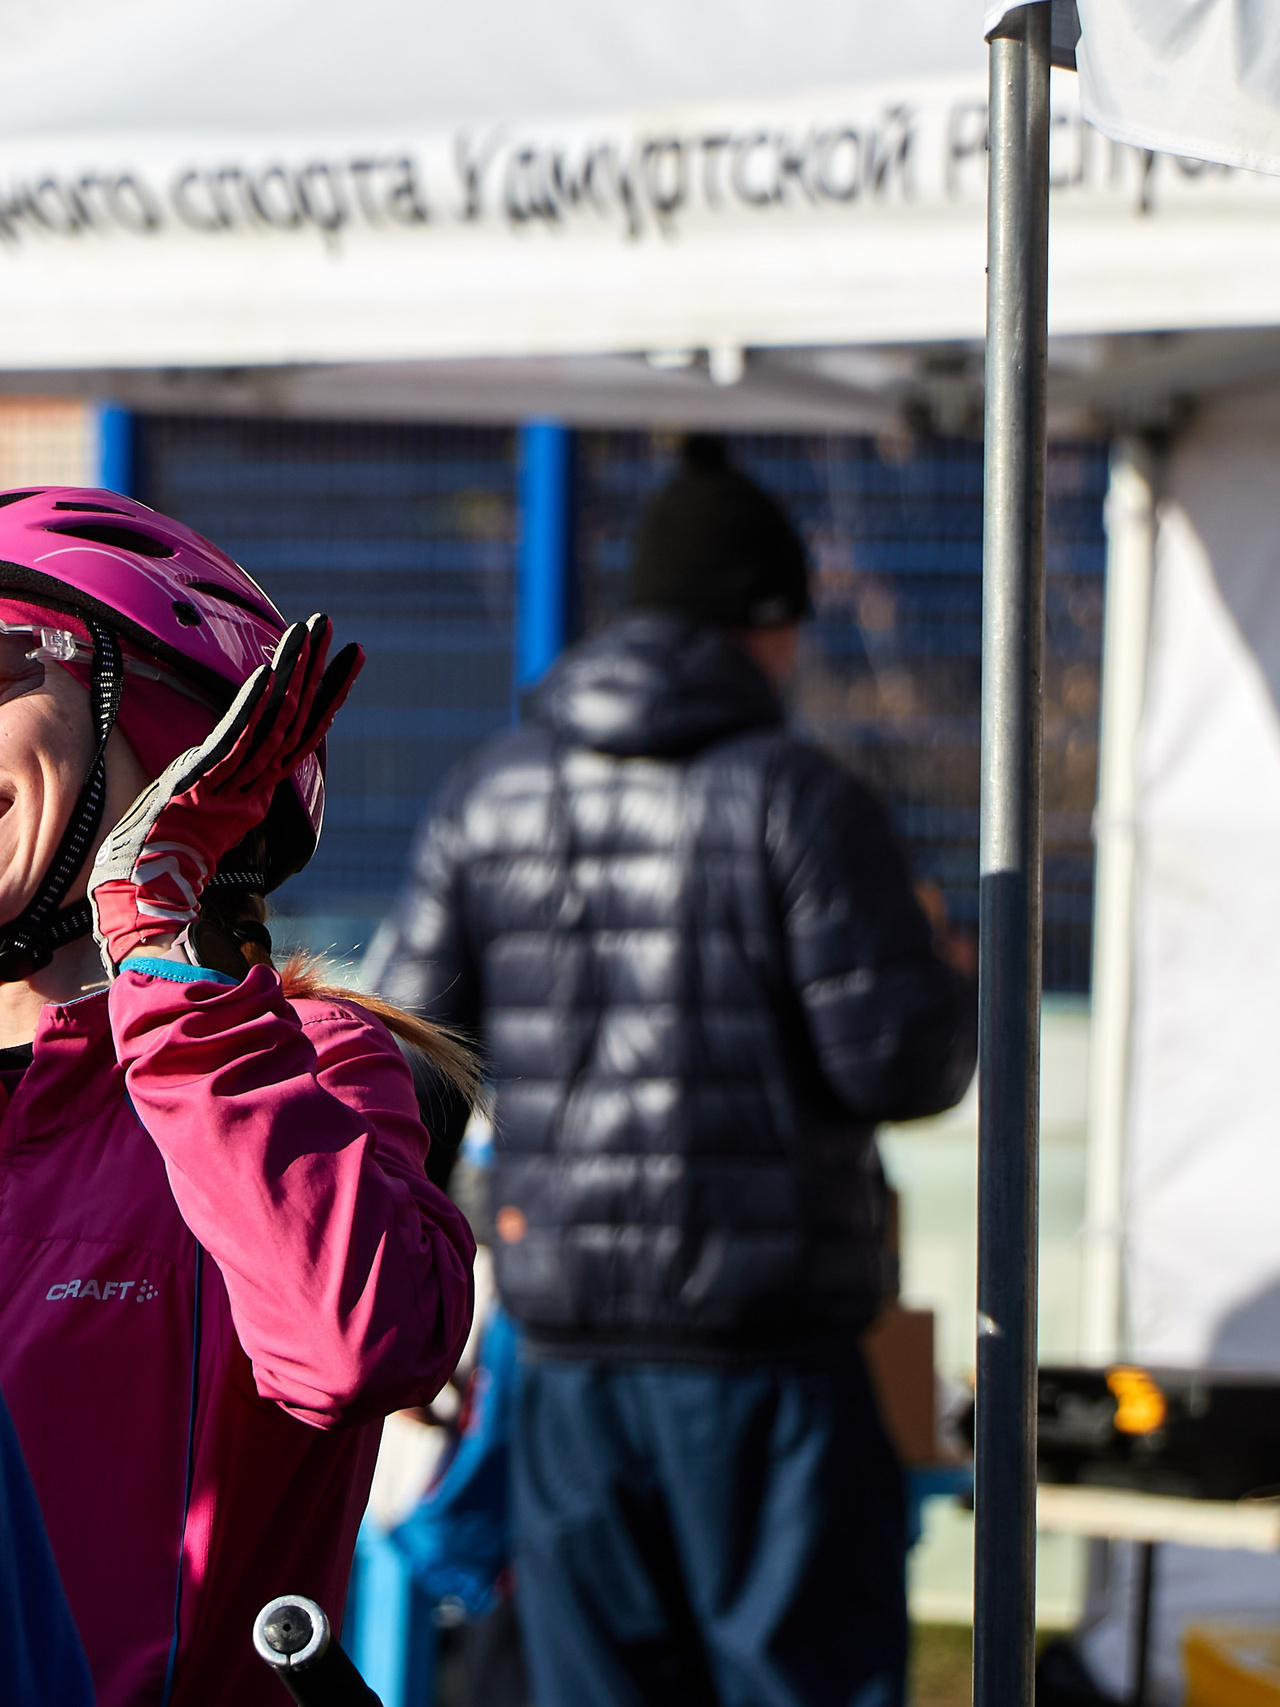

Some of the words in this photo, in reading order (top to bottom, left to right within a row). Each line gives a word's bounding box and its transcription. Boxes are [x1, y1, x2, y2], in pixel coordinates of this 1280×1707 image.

[171, 153, 430, 260] спорта
[454, 104, 920, 242] Удмуртской
[46, 1279, 135, 1301] CRAFT
